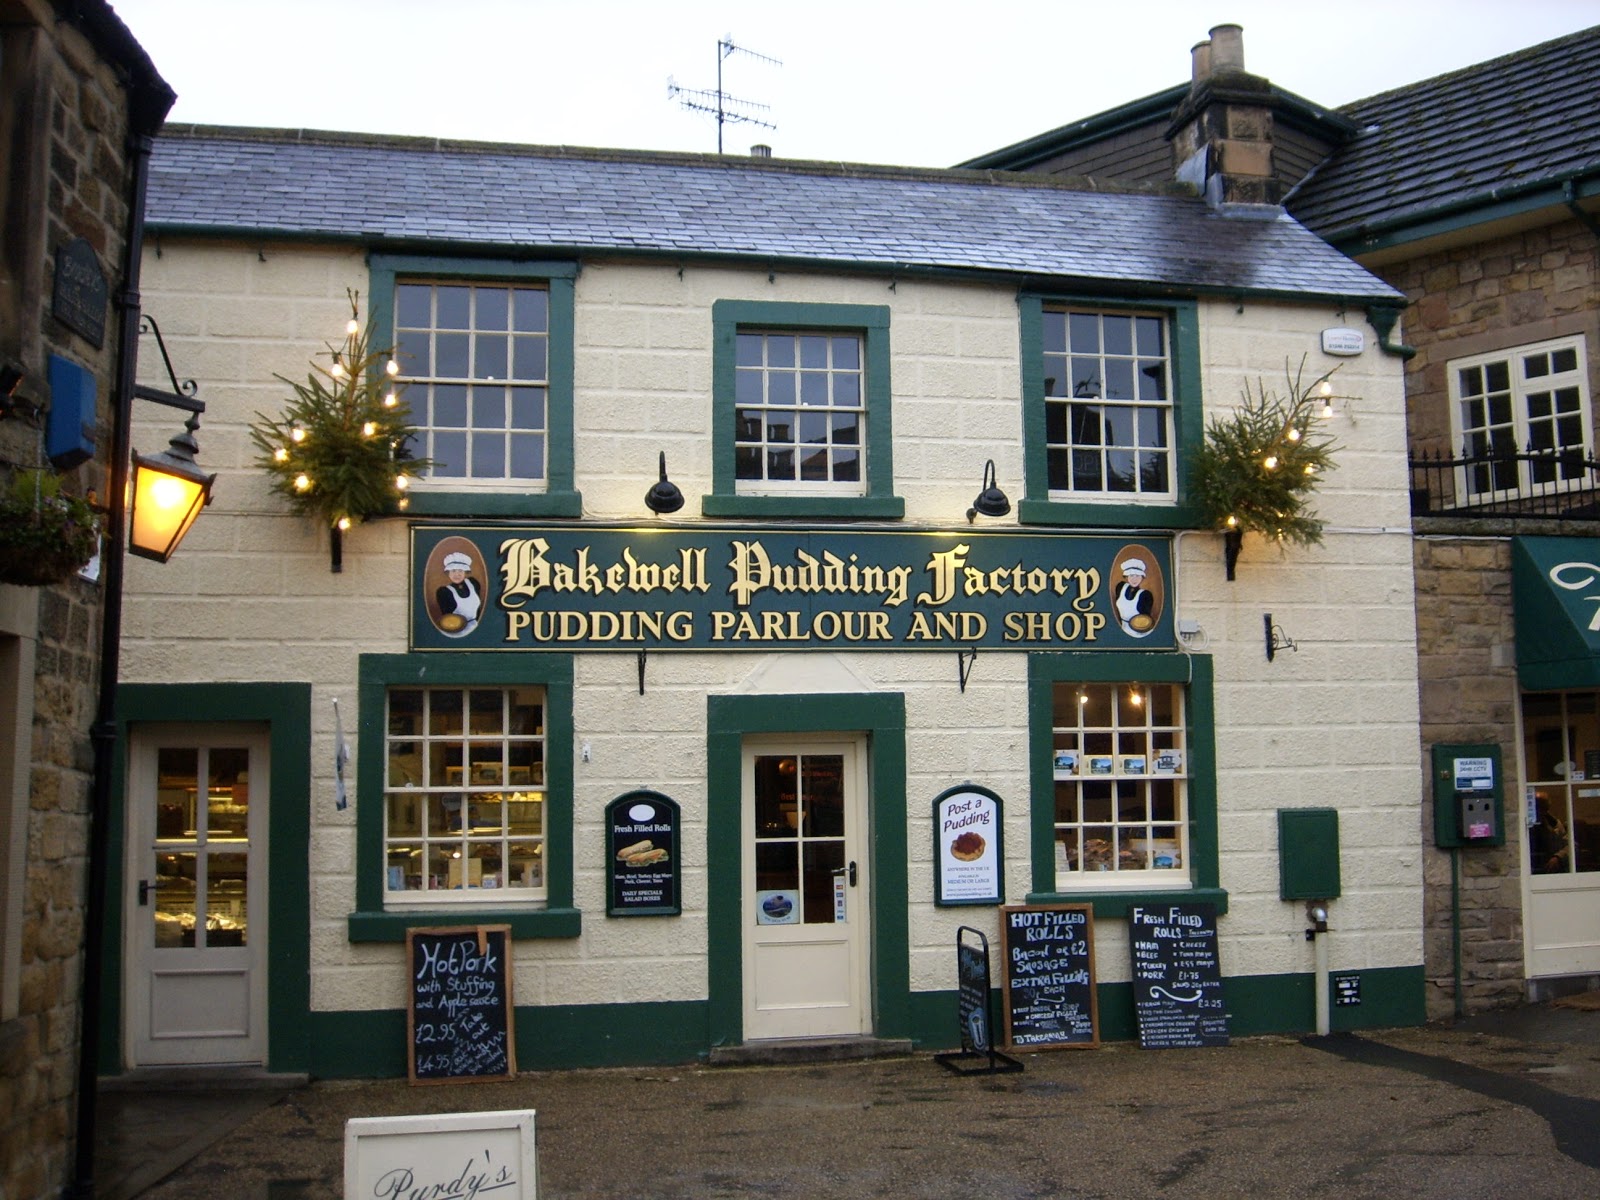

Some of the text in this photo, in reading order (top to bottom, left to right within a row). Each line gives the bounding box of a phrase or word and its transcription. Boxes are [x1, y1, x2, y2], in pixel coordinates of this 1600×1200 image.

[500, 537, 1100, 611] Bakewell Pudding Factory
[505, 611, 1106, 641] PUDDING PARLOUR AND SHOP
[948, 799, 982, 816] Post a
[614, 825, 633, 833] Fresh
[655, 824, 671, 832] Rolls
[944, 810, 990, 832] Pudding
[1010, 912, 1086, 928] HOT FILLED
[1133, 907, 1165, 924] FRESH
[1026, 925, 1074, 941] ROLLS
[1154, 927, 1181, 938] ROLLS
[1071, 940, 1088, 956] £2
[1140, 941, 1159, 950] HAM
[417, 940, 497, 979] Hot Pork
[1141, 951, 1158, 959] BEEF
[1142, 962, 1166, 971] TURKEY
[417, 976, 495, 996] with Stuffing
[1011, 974, 1052, 989] EXTRA
[1044, 986, 1066, 995] EACH
[416, 992, 498, 1017] and Apple sauce
[460, 1012, 484, 1032] Take
[416, 1023, 456, 1044] £2.95
[472, 1022, 490, 1040] out
[374, 1150, 514, 1200] Purdy's
